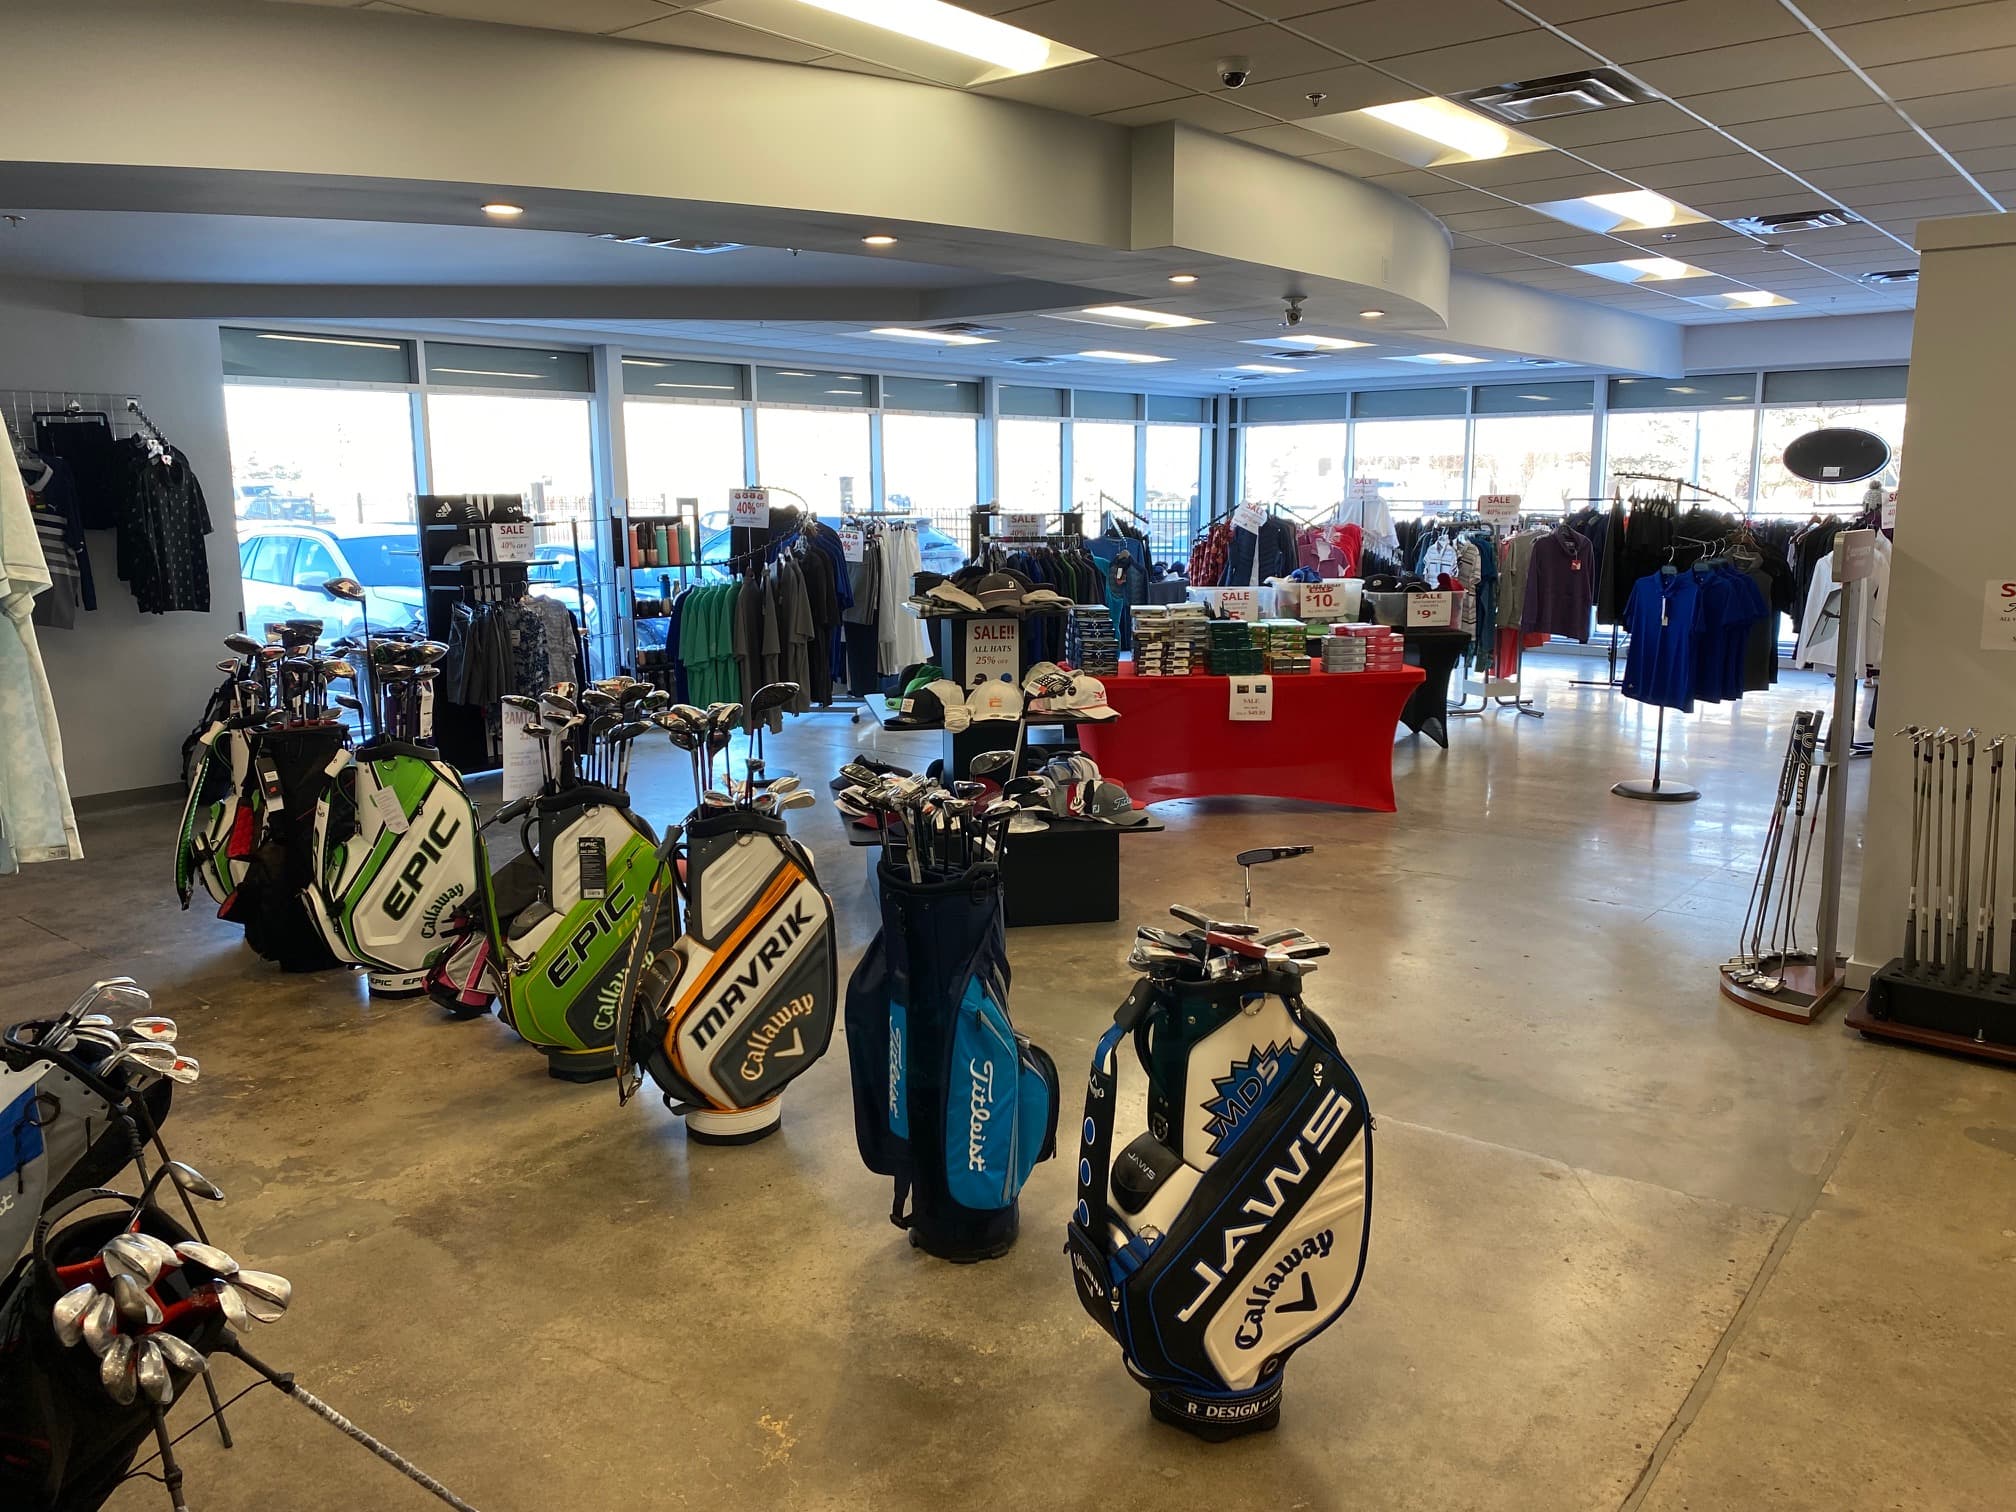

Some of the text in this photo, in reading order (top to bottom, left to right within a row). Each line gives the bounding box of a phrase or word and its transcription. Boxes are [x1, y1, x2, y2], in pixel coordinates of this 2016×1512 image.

[736, 501, 756, 514] 40%
[1487, 496, 1511, 504] SALE
[500, 525, 525, 535] SALE
[1011, 514, 1037, 523] SALE
[1222, 592, 1250, 601] SALE
[973, 624, 1015, 640] SALE!!
[972, 645, 1012, 653] ALL HATS
[975, 655, 996, 665] 25%
[382, 806, 461, 921] EPIC
[421, 882, 464, 939] Callaway
[546, 880, 635, 989] EPIC
[687, 896, 815, 1052] MAVRIK
[740, 992, 815, 1081] Callaway
[1217, 1056, 1279, 1138] MD5
[969, 1056, 995, 1173] Titleist
[1127, 1152, 1157, 1180] JAWS
[1177, 1088, 1354, 1323] JAWS
[1234, 1229, 1335, 1350] Callaway
[1206, 1401, 1260, 1418] DESIGN
